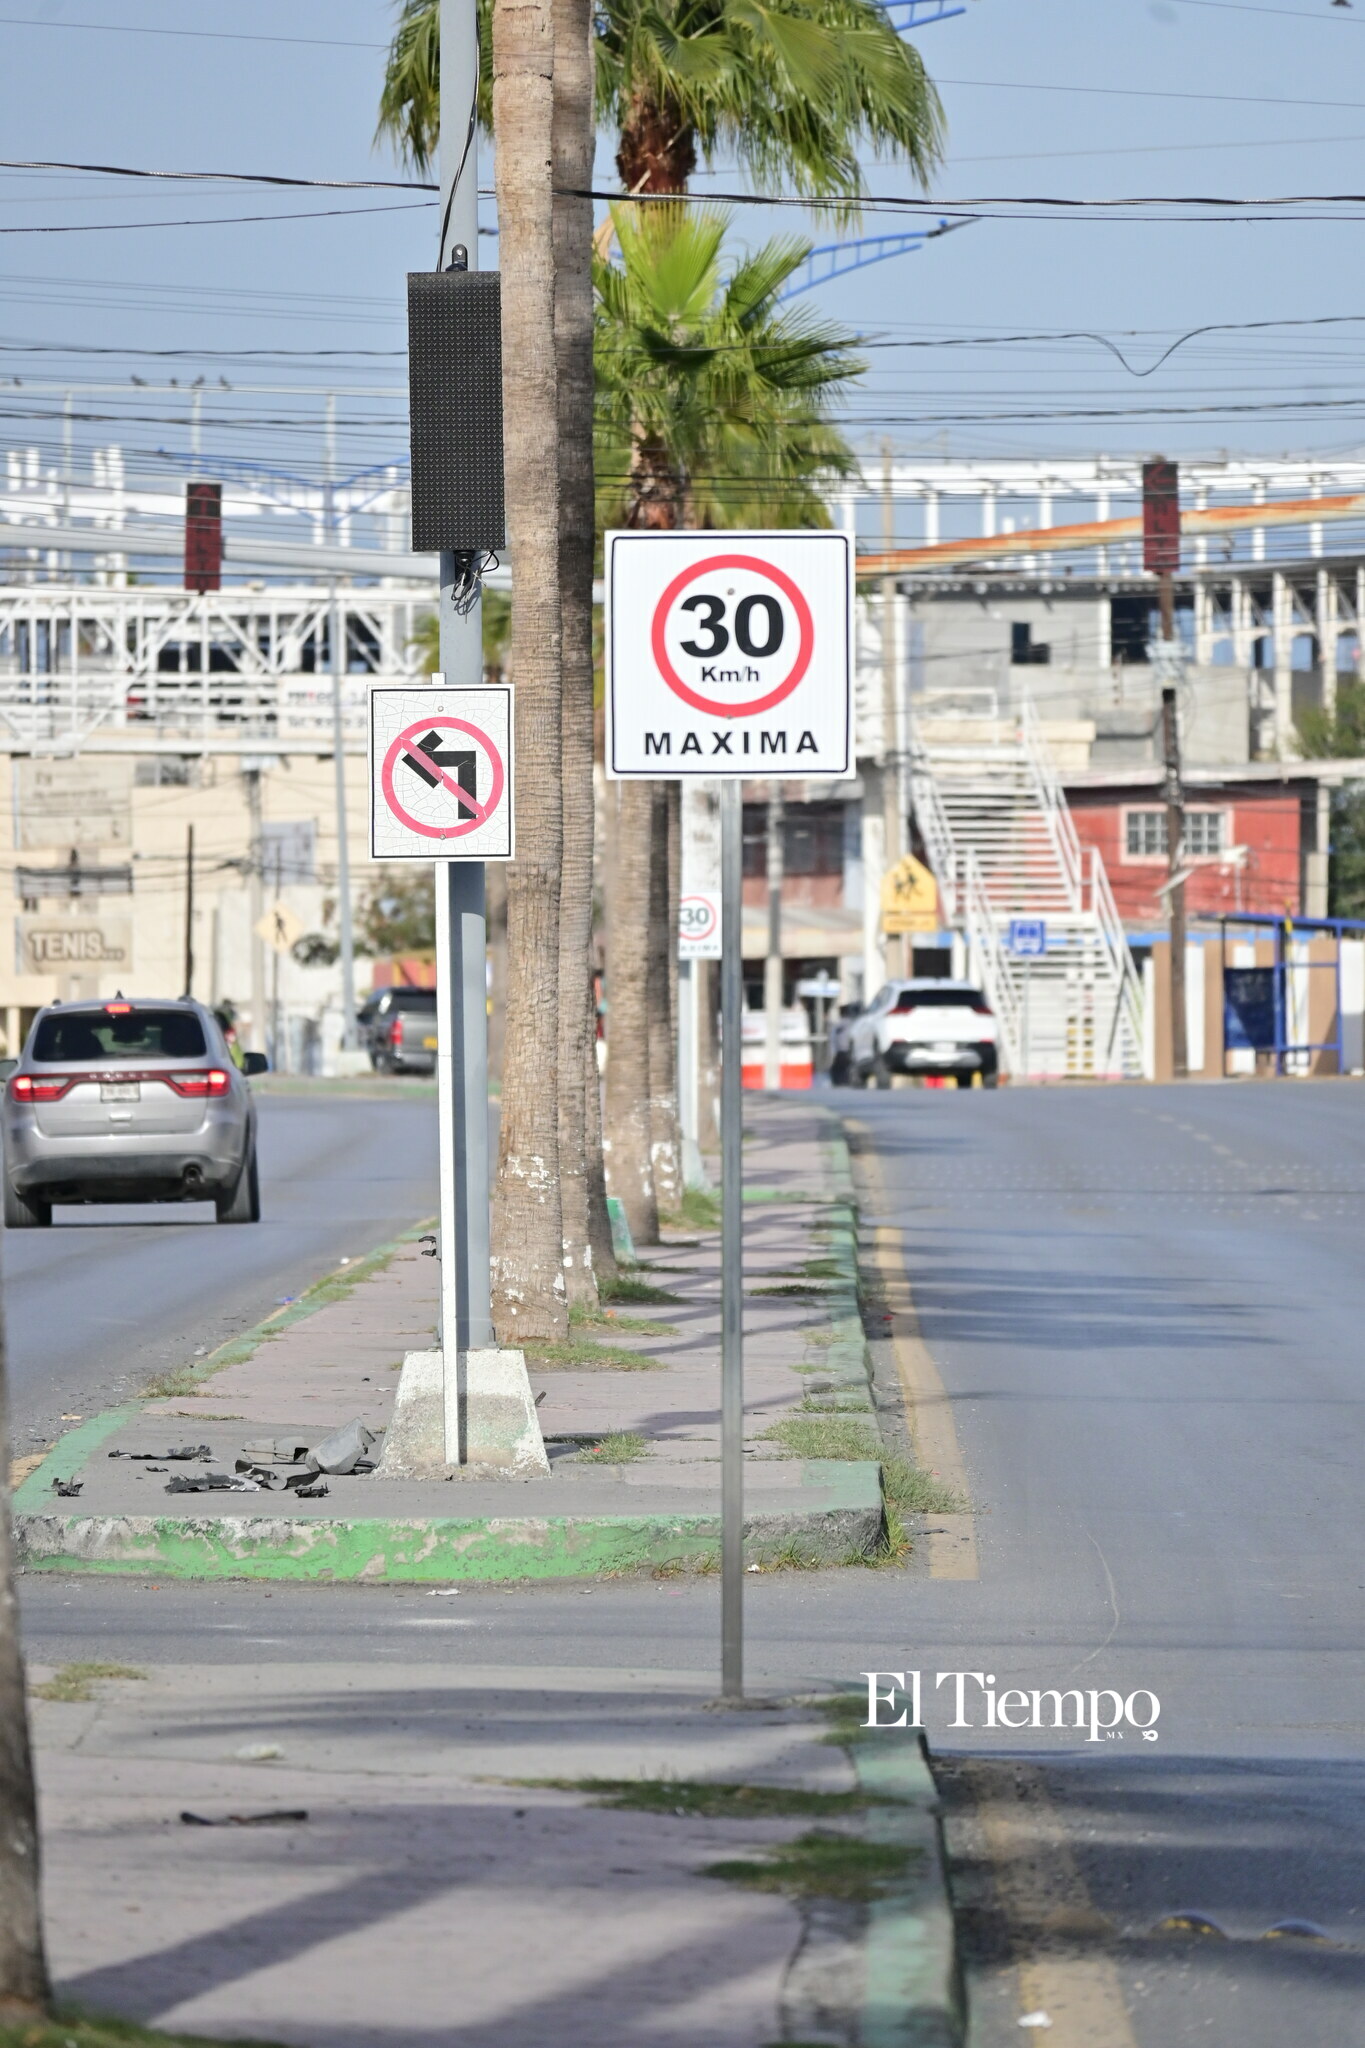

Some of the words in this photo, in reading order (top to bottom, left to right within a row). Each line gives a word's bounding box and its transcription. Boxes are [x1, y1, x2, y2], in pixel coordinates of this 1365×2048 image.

[680, 594, 784, 658] 30
[701, 666, 760, 683] Km/h
[644, 730, 819, 756] MAXIMA
[679, 907, 709, 926] 30
[680, 944, 719, 952] AXIMA
